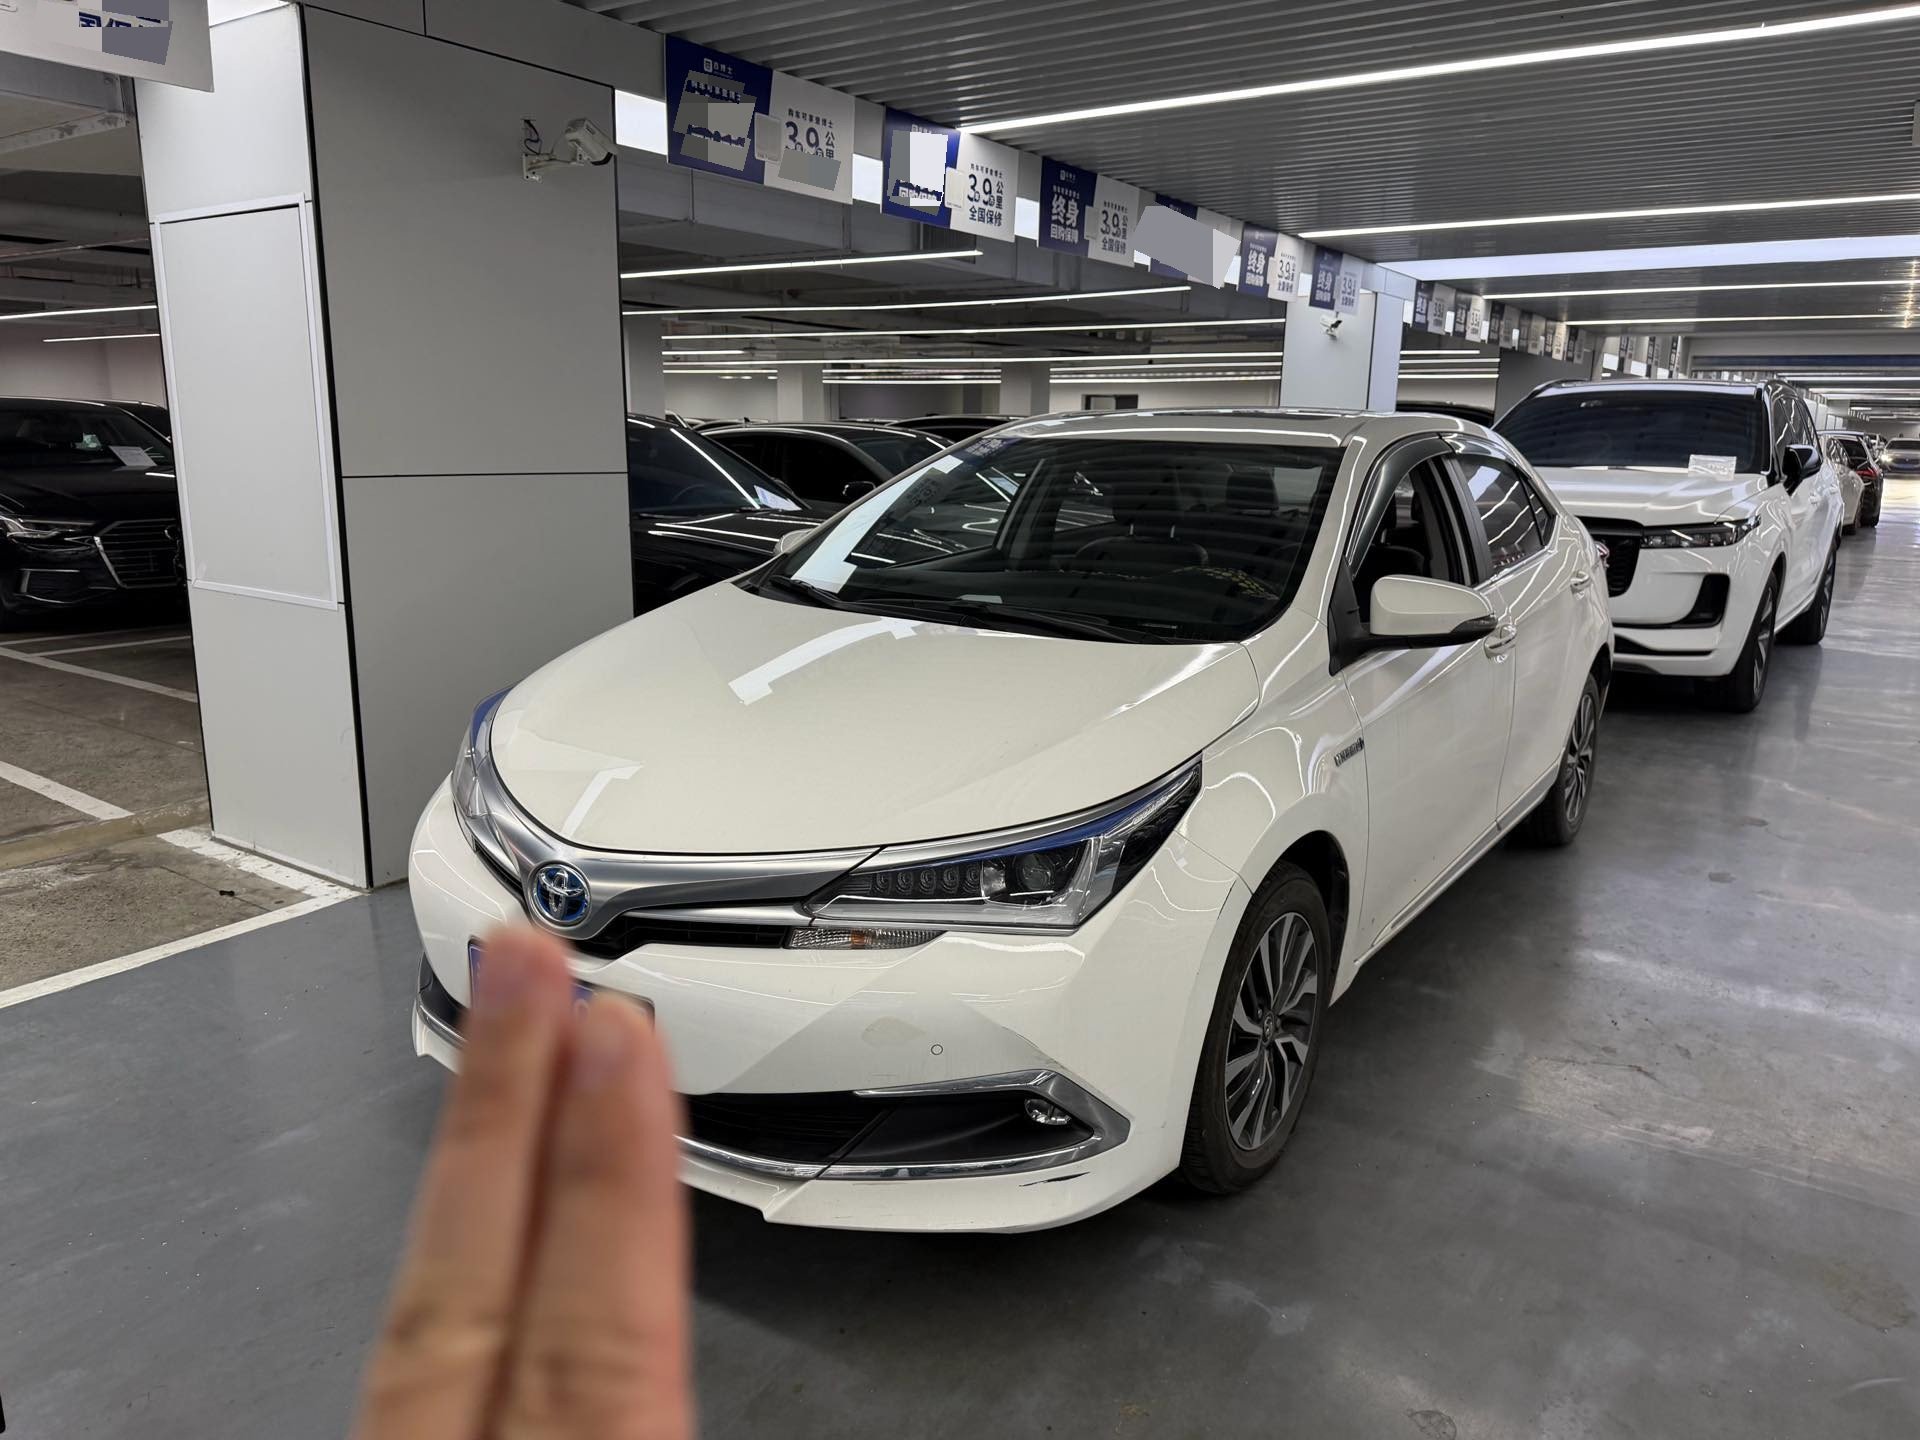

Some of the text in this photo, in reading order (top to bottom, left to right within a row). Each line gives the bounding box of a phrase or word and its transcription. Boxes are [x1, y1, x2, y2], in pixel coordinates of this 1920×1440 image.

[969, 205, 1002, 227] 全国保修
[1051, 193, 1079, 227] 终身
